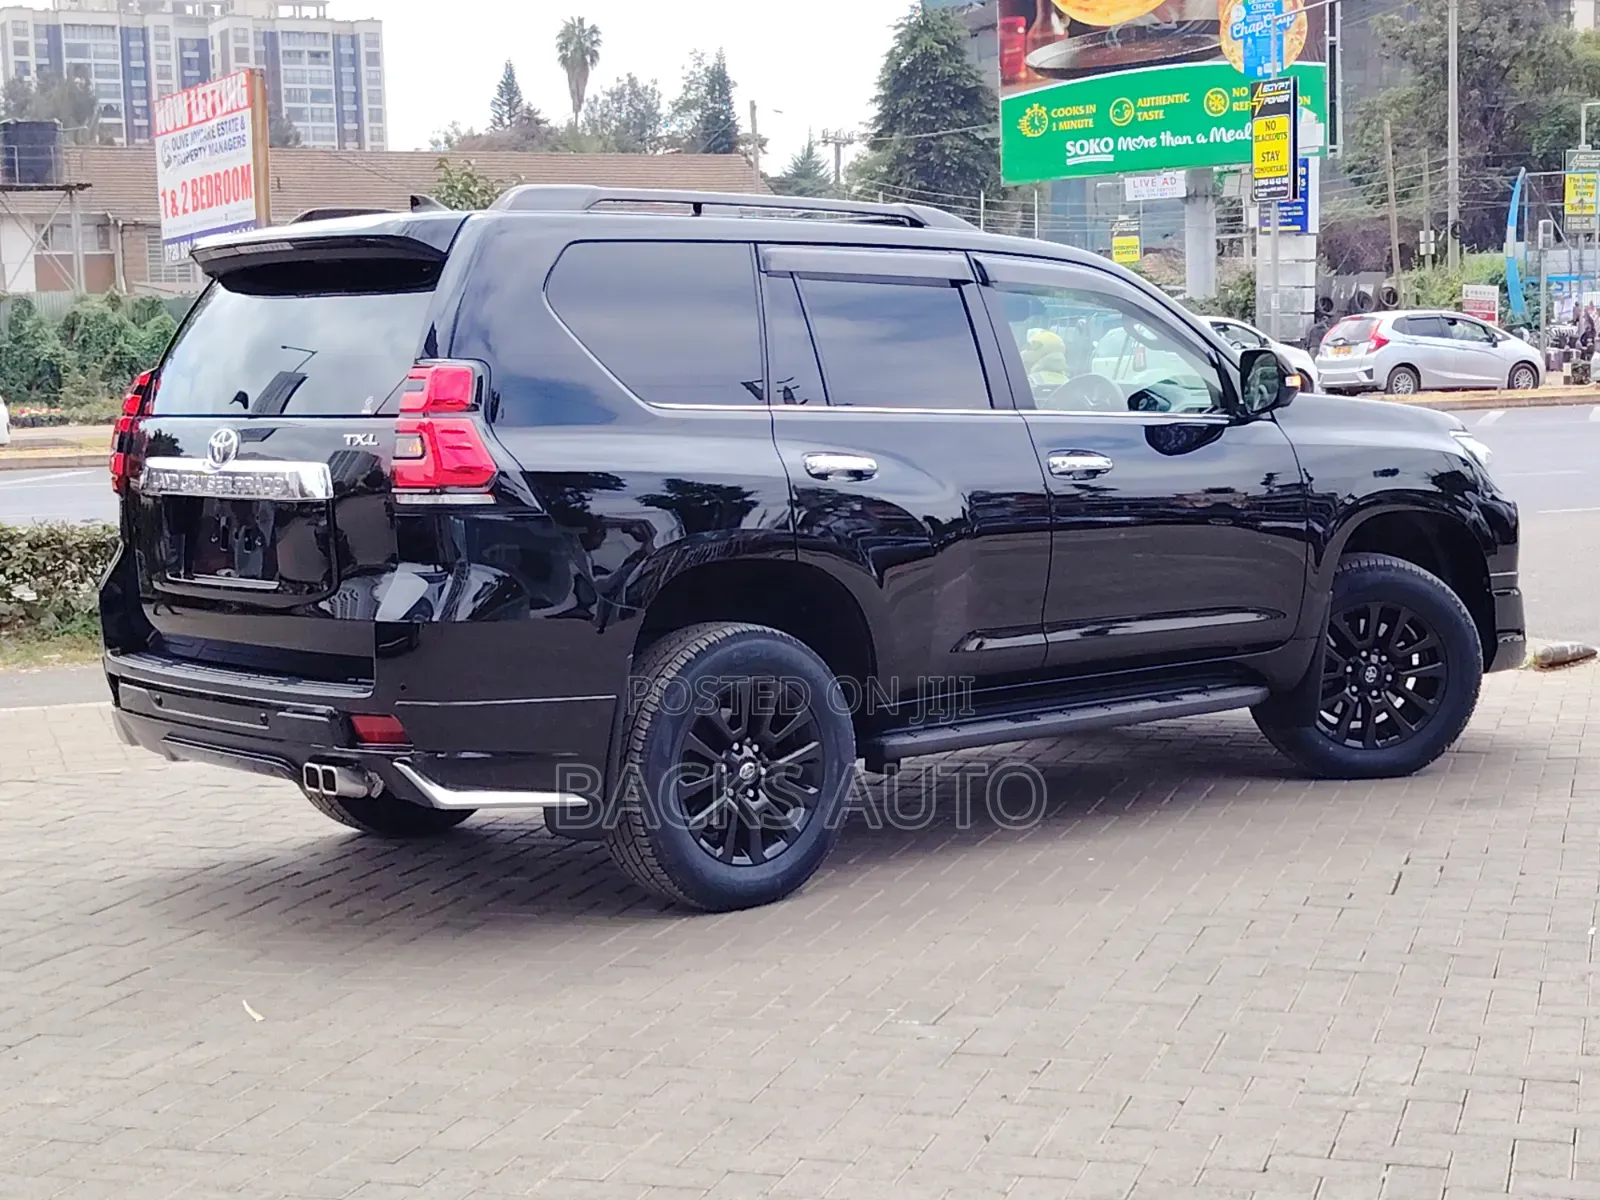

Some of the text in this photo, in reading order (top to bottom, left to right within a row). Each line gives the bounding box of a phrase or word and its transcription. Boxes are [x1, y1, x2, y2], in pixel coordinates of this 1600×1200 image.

[1232, 87, 1248, 97] NO
[155, 72, 248, 134] NOW LETTING
[1137, 93, 1190, 107] AUTHENTIC
[1264, 94, 1290, 105] POWER
[1051, 104, 1096, 118] COOKS IN
[1137, 110, 1165, 121] TASTE
[216, 117, 239, 138] ESTATE
[1052, 118, 1094, 131] 1 MINUTE
[1265, 120, 1276, 131] NO
[208, 134, 246, 156] MANAGERS
[1065, 122, 1252, 156] SOKO More than a Meal
[1261, 150, 1281, 162] STAY
[1133, 176, 1177, 189] LIVE AD
[161, 163, 252, 219] 1 & 2 BEDROOM
